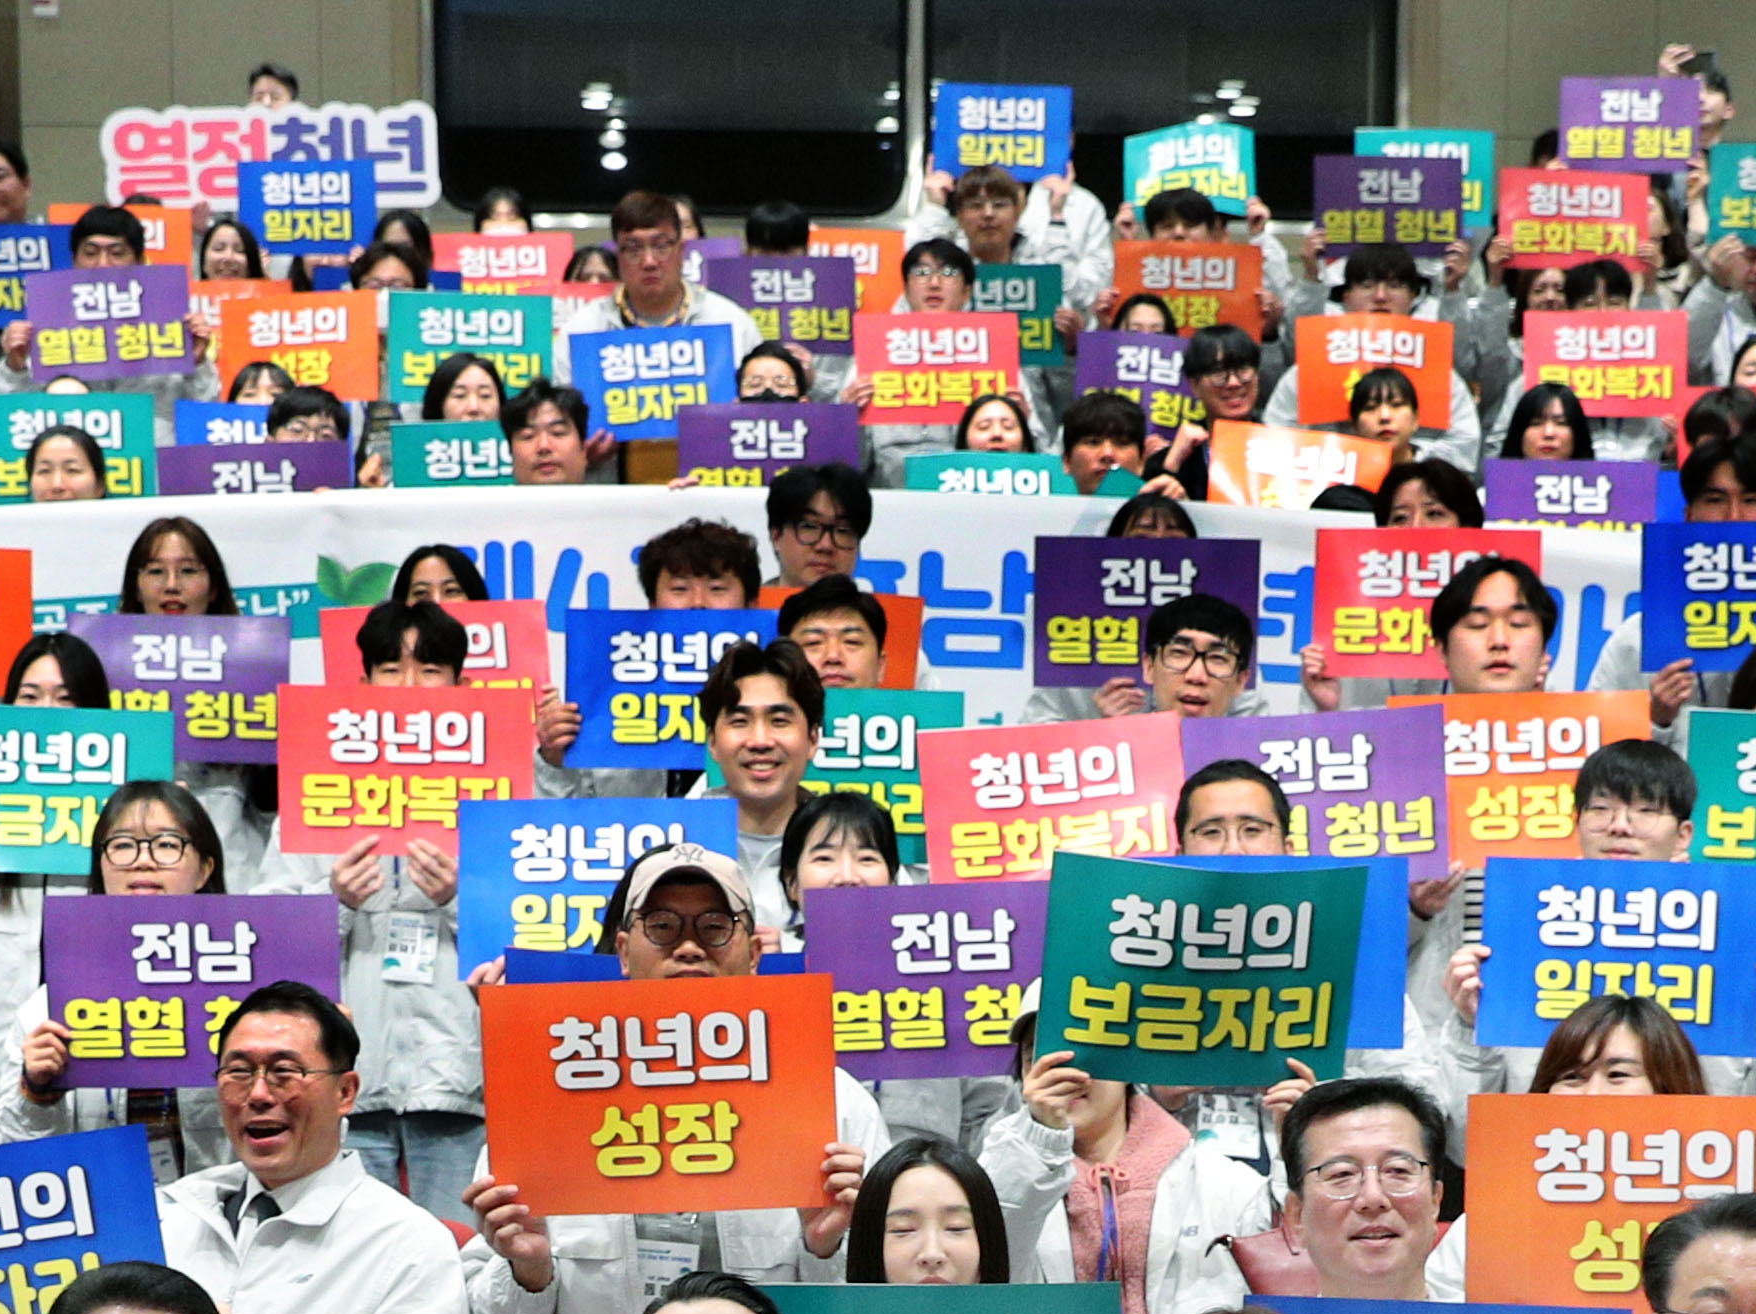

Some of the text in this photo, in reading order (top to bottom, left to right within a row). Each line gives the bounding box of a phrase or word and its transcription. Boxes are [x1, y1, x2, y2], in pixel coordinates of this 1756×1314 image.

[957, 97, 1046, 131] 청년의
[1600, 88, 1663, 122] 전남
[957, 135, 1045, 168] 일자리
[1148, 133, 1233, 172] 청년의
[1566, 126, 1693, 160] 열혈 청년
[261, 172, 351, 205] 청년의
[1358, 169, 1423, 204] 전남
[1527, 183, 1623, 219] 청년의
[263, 210, 352, 242] 일자리
[1322, 208, 1458, 244] 열혈 청년
[1511, 220, 1638, 257] 문화복지
[458, 246, 547, 277] 청년의
[1141, 255, 1236, 290] 청년의
[72, 282, 142, 321] 전남
[750, 268, 815, 303] 전남
[36, 320, 186, 366] 열혈 청년
[248, 307, 348, 344] 청년의
[418, 309, 524, 346] 청년의
[790, 307, 851, 342] 청년
[1554, 324, 1657, 360] 청년의
[600, 339, 705, 382] 청년의
[885, 327, 990, 365] 청년의
[1116, 344, 1185, 385] 전남
[1326, 329, 1425, 367] 청년의
[604, 383, 707, 424] 일자리
[871, 370, 1008, 409] 문화복지
[730, 419, 807, 461] 전남
[212, 459, 297, 494] 전남
[1533, 474, 1611, 515] 전남
[1099, 557, 1198, 607] 전남
[130, 633, 228, 681] 전남
[1046, 614, 1140, 666] 열혈
[184, 691, 278, 740] 청년
[326, 709, 486, 765] 청년의
[1443, 715, 1603, 775] 청년의
[968, 741, 1136, 811] 청년의
[1257, 734, 1374, 794] 전남
[1324, 795, 1437, 858] 청년
[1465, 784, 1577, 843] 성장
[1107, 891, 1316, 972] 청년의
[1534, 886, 1721, 952] 청년의
[129, 920, 257, 985] 전남
[889, 907, 1018, 977] 전남
[63, 999, 187, 1061] 열혈
[832, 987, 946, 1053] 열혈
[1060, 972, 1336, 1054] 보금자리
[547, 1007, 770, 1092] 청년의
[590, 1099, 741, 1179] 성장
[1532, 1127, 1756, 1204] 청년의
